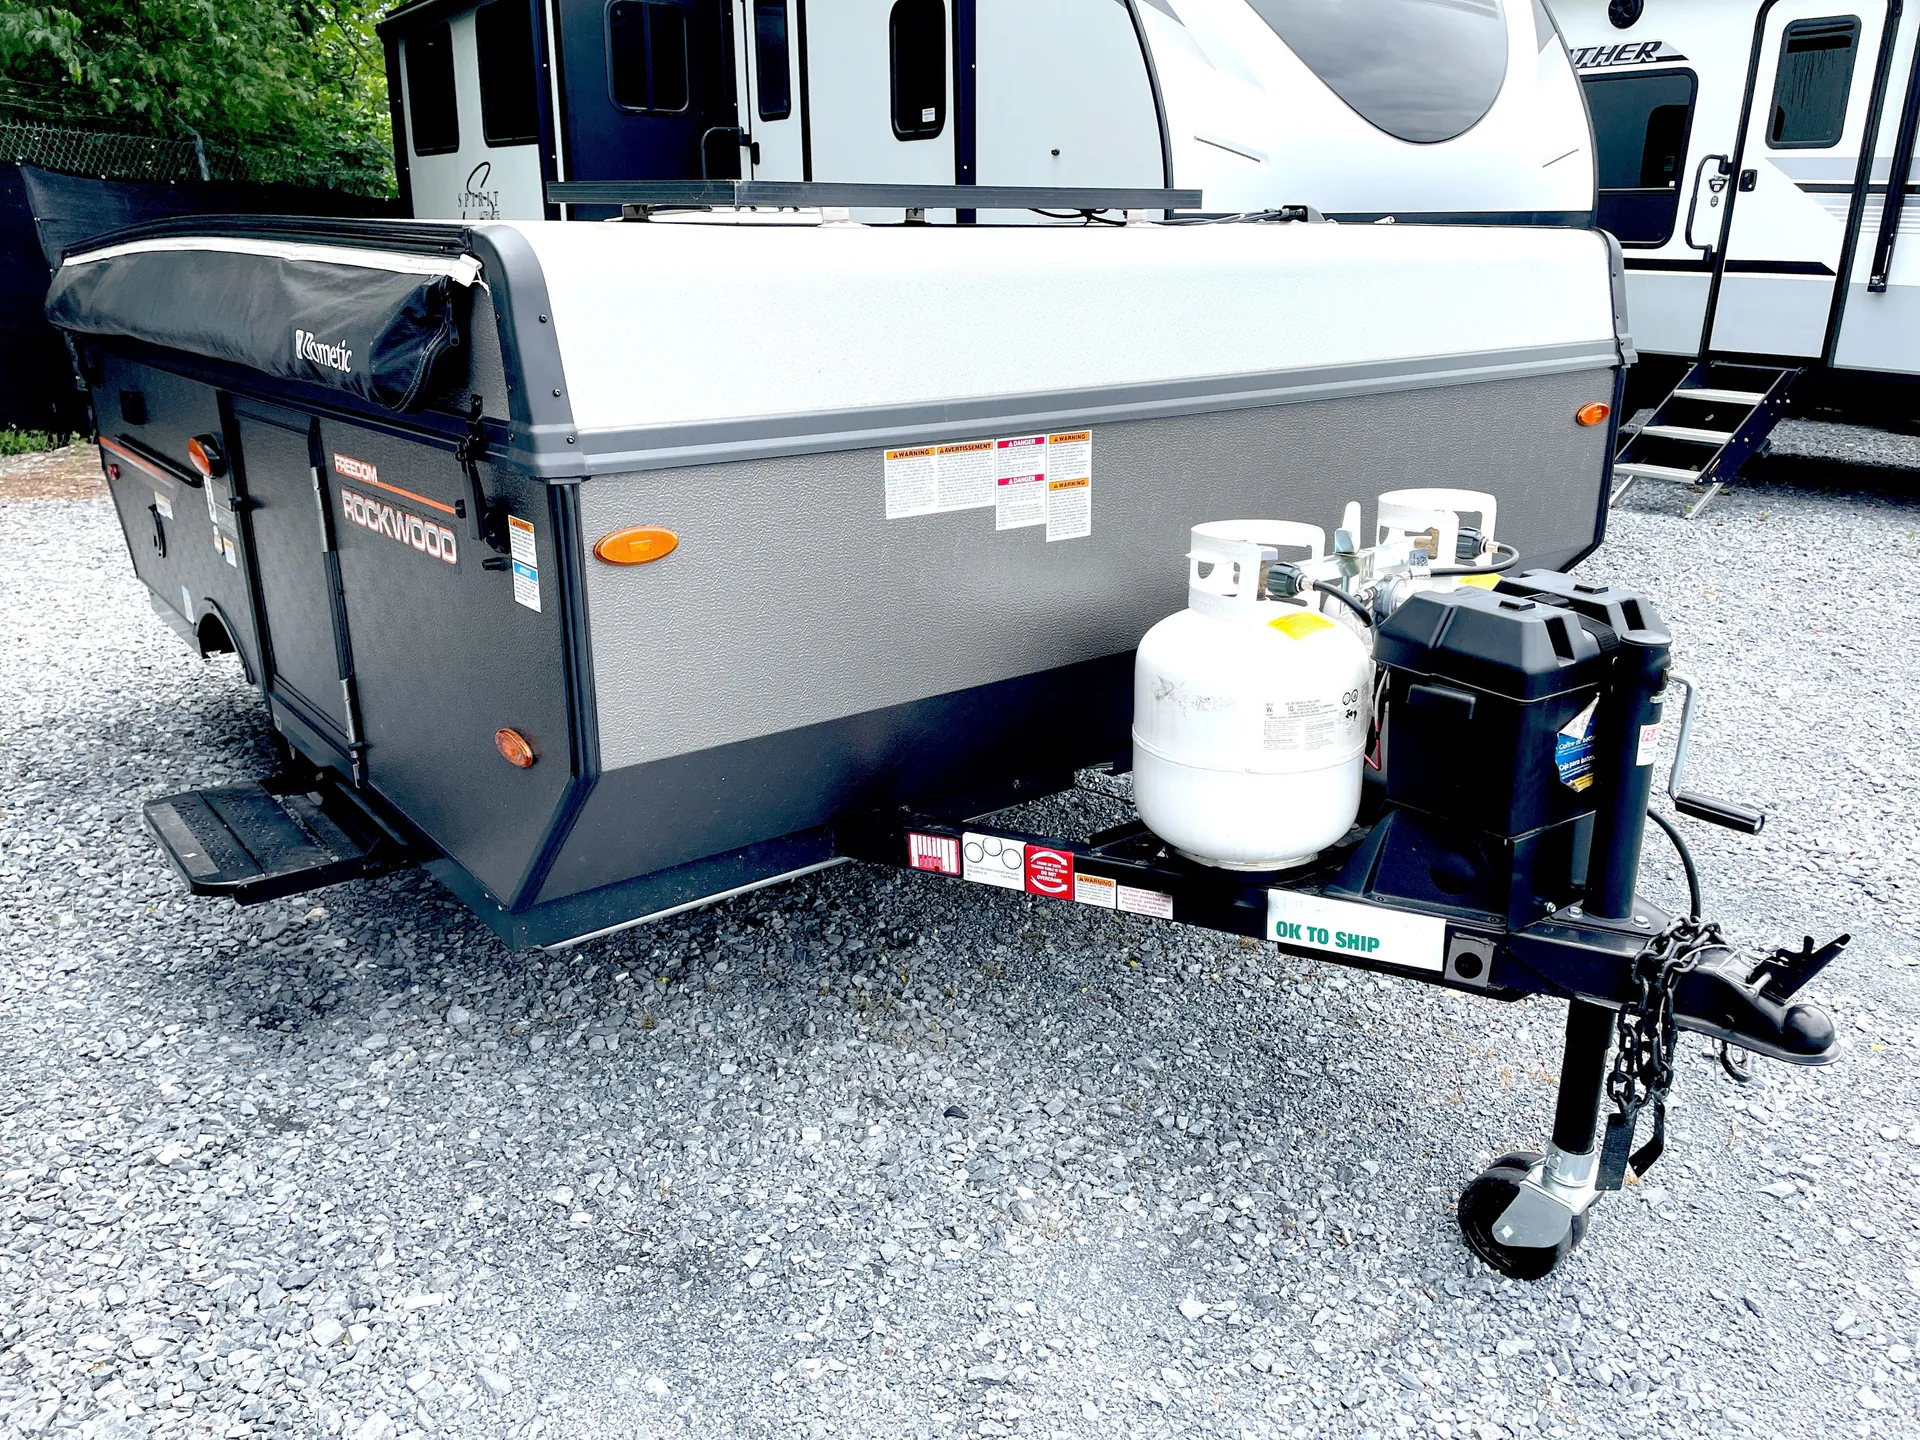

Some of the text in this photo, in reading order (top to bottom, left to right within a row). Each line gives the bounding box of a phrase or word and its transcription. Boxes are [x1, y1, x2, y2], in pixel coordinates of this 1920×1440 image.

[1570, 41, 1662, 67] THER
[458, 191, 499, 208] SPIRIT
[302, 331, 352, 373] Dometic
[1013, 438, 1036, 447] DANGER
[1058, 433, 1086, 442] WARNING
[898, 449, 930, 458] WARNING
[944, 442, 992, 454] AVERTISSEMENT
[334, 454, 378, 483] FREEDOM
[1013, 475, 1036, 484] DANGER
[1058, 479, 1085, 489] WARNING
[341, 488, 457, 565] ROCKWOOD
[1083, 875, 1112, 887] WARNING
[1276, 920, 1380, 953] OK TO SHIP
